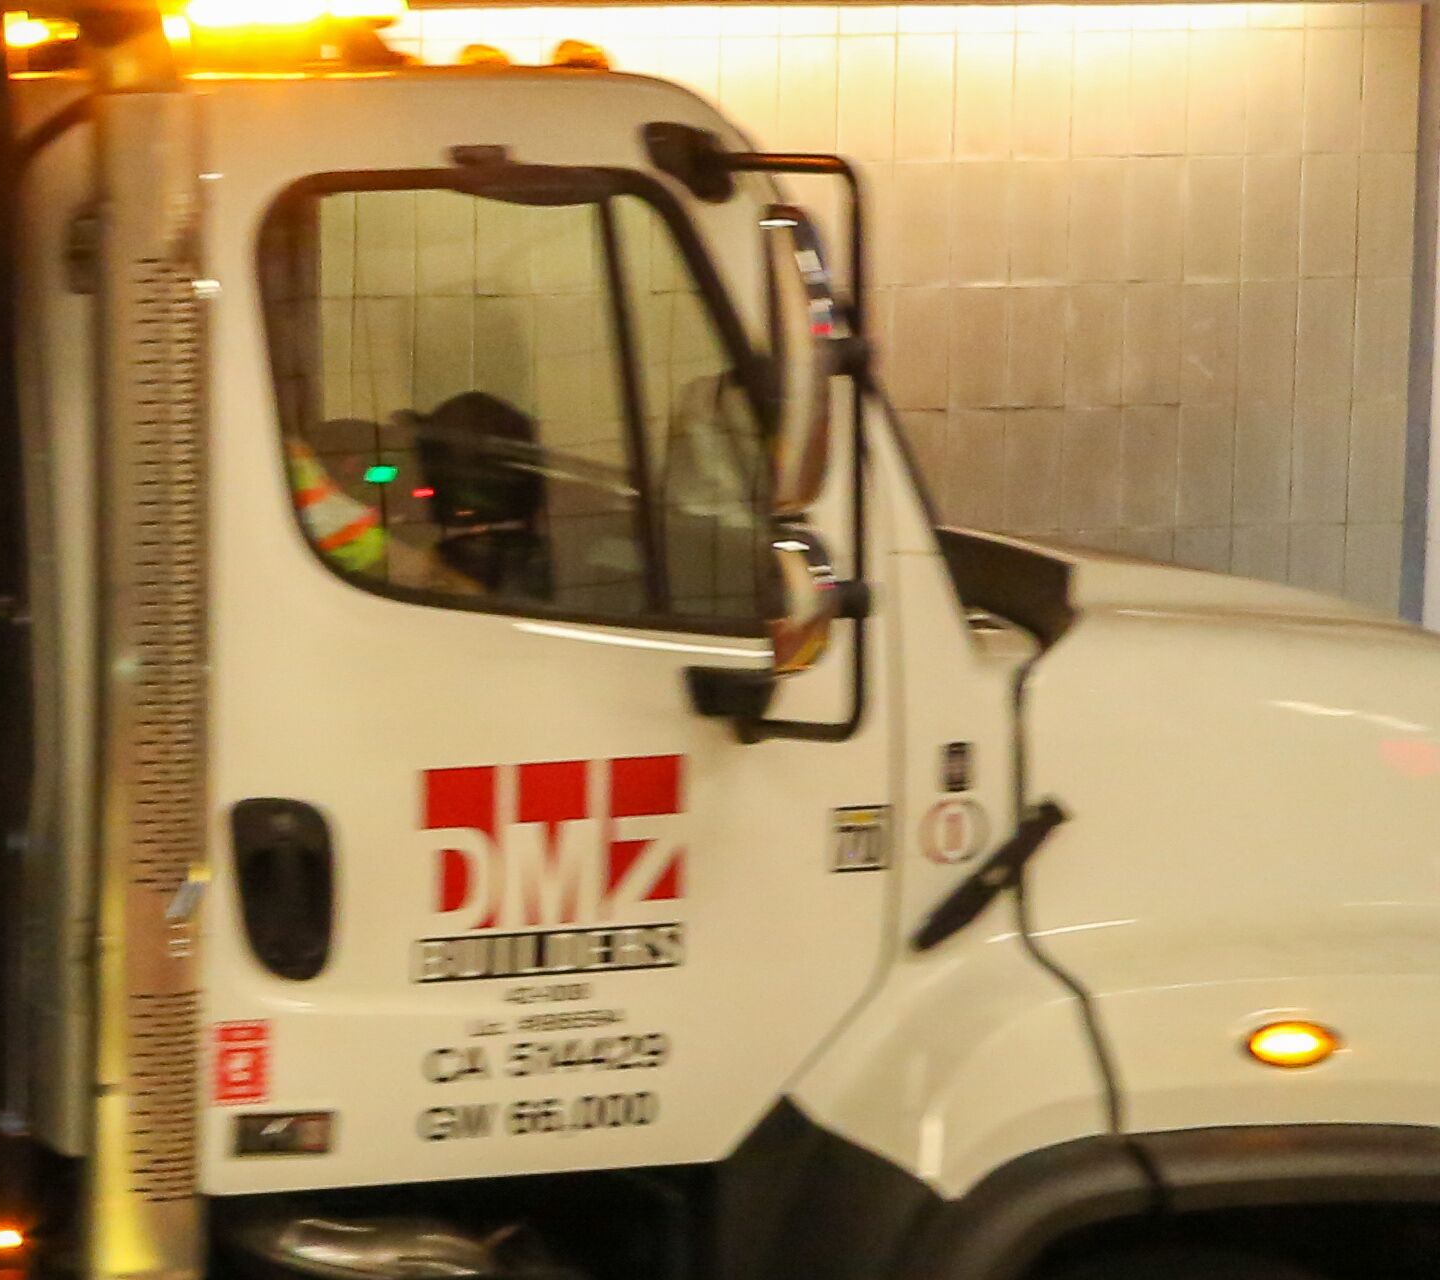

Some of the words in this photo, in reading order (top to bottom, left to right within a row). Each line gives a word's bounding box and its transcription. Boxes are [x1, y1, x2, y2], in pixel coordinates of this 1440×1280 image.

[418, 812, 688, 929] DMZ
[422, 1044, 492, 1084] CA
[417, 1104, 496, 1142] GW
